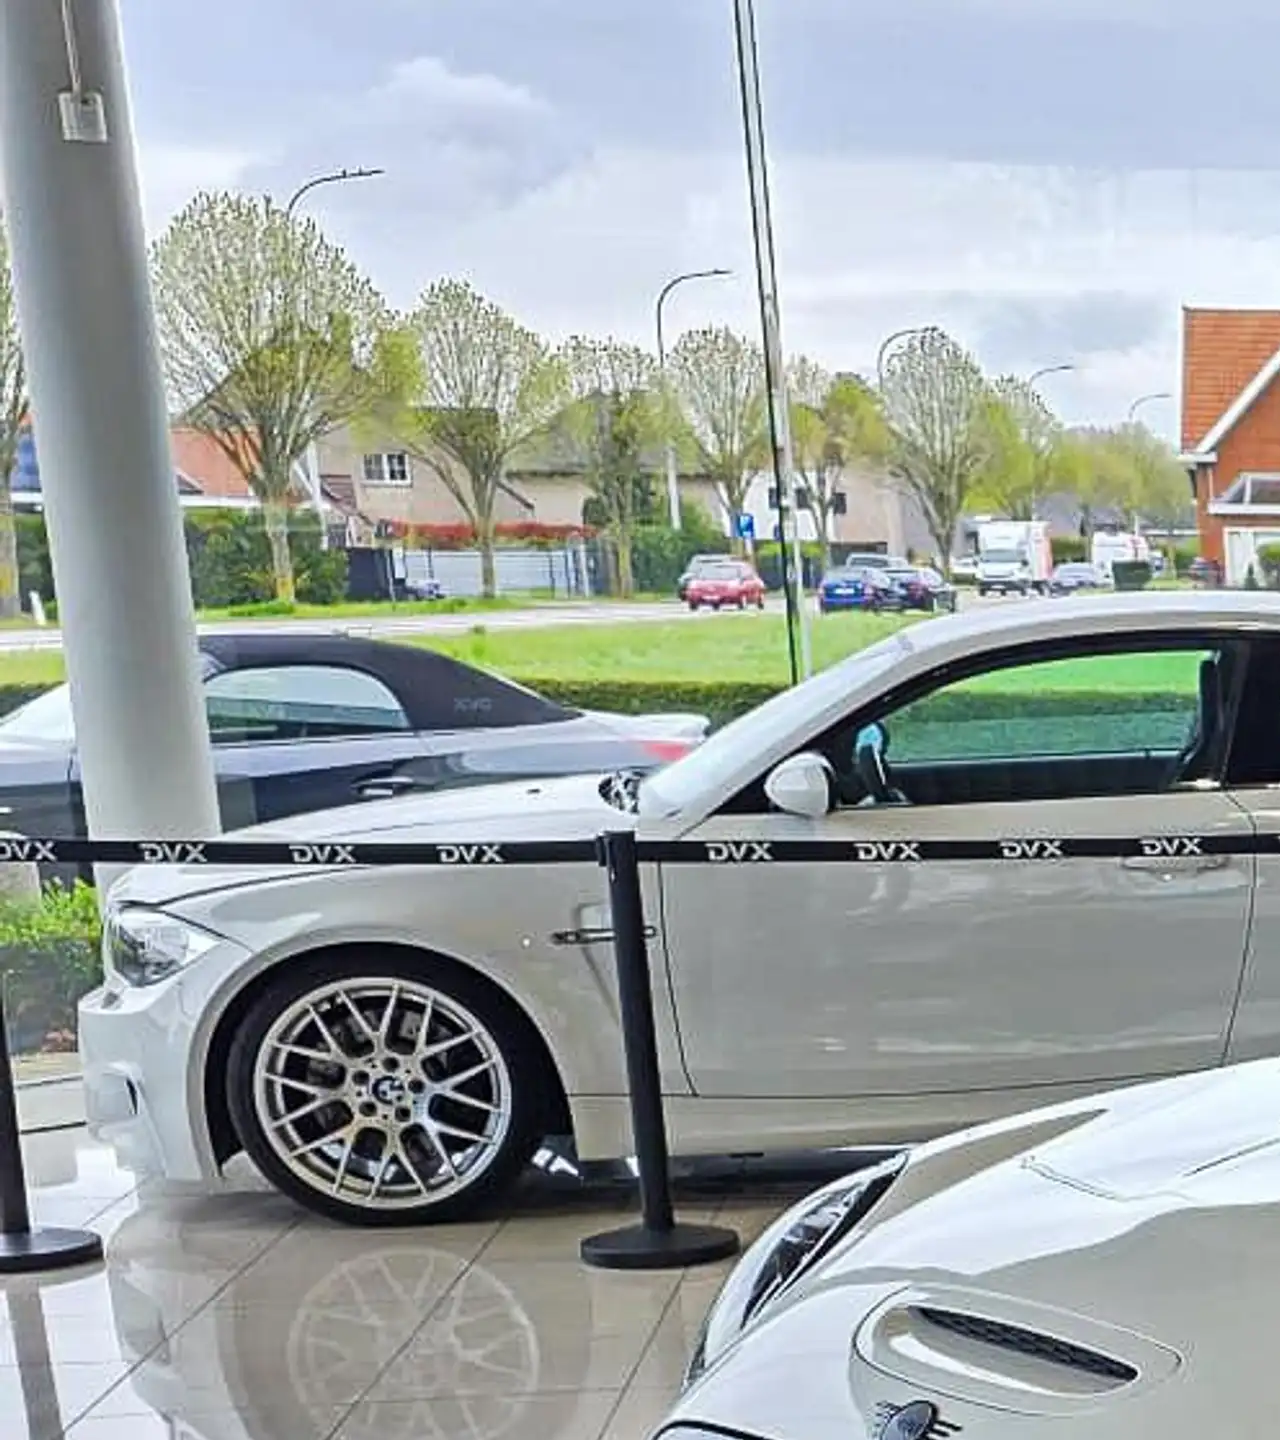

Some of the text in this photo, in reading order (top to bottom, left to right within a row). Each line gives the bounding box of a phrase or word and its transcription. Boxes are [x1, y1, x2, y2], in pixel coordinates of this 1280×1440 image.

[138, 843, 207, 862] DVX
[289, 845, 356, 863] DVX
[436, 845, 504, 863] DVX
[705, 843, 773, 860] DVX
[854, 843, 921, 860] DVX
[1000, 840, 1063, 858] DVX
[1139, 838, 1202, 855] DVX
